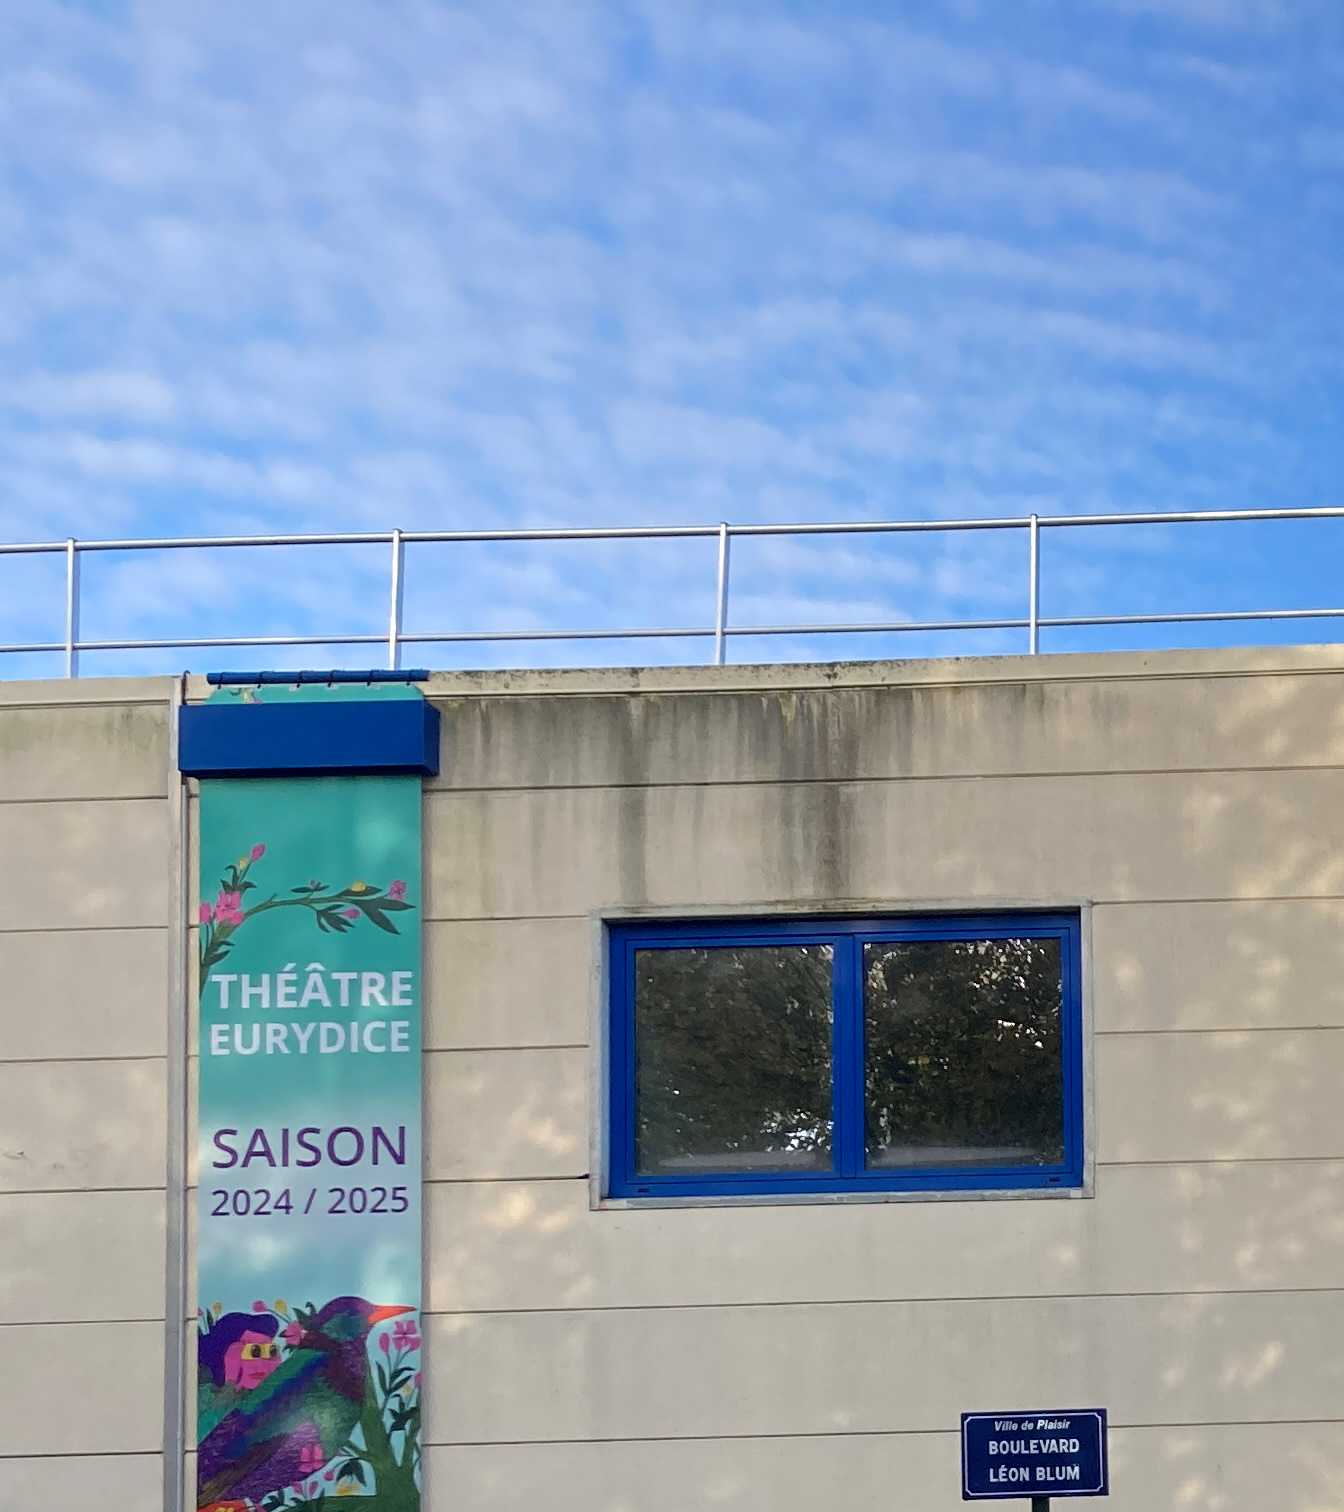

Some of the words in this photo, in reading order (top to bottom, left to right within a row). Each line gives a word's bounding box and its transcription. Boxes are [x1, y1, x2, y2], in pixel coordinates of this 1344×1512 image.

[211, 962, 413, 1010] THÉÂTRE
[210, 1020, 411, 1056] EURYDICE
[212, 1125, 406, 1170] SAISON
[211, 1188, 294, 1217] 2024
[303, 1187, 318, 1215] /
[327, 1186, 410, 1214] 2025
[994, 1420, 1019, 1432] Ville
[1021, 1420, 1035, 1431] de
[1036, 1419, 1071, 1431] Plaisir
[988, 1438, 1080, 1455] BOULEVARD
[989, 1464, 1030, 1483] LÉON
[1036, 1463, 1081, 1481] BLUM
